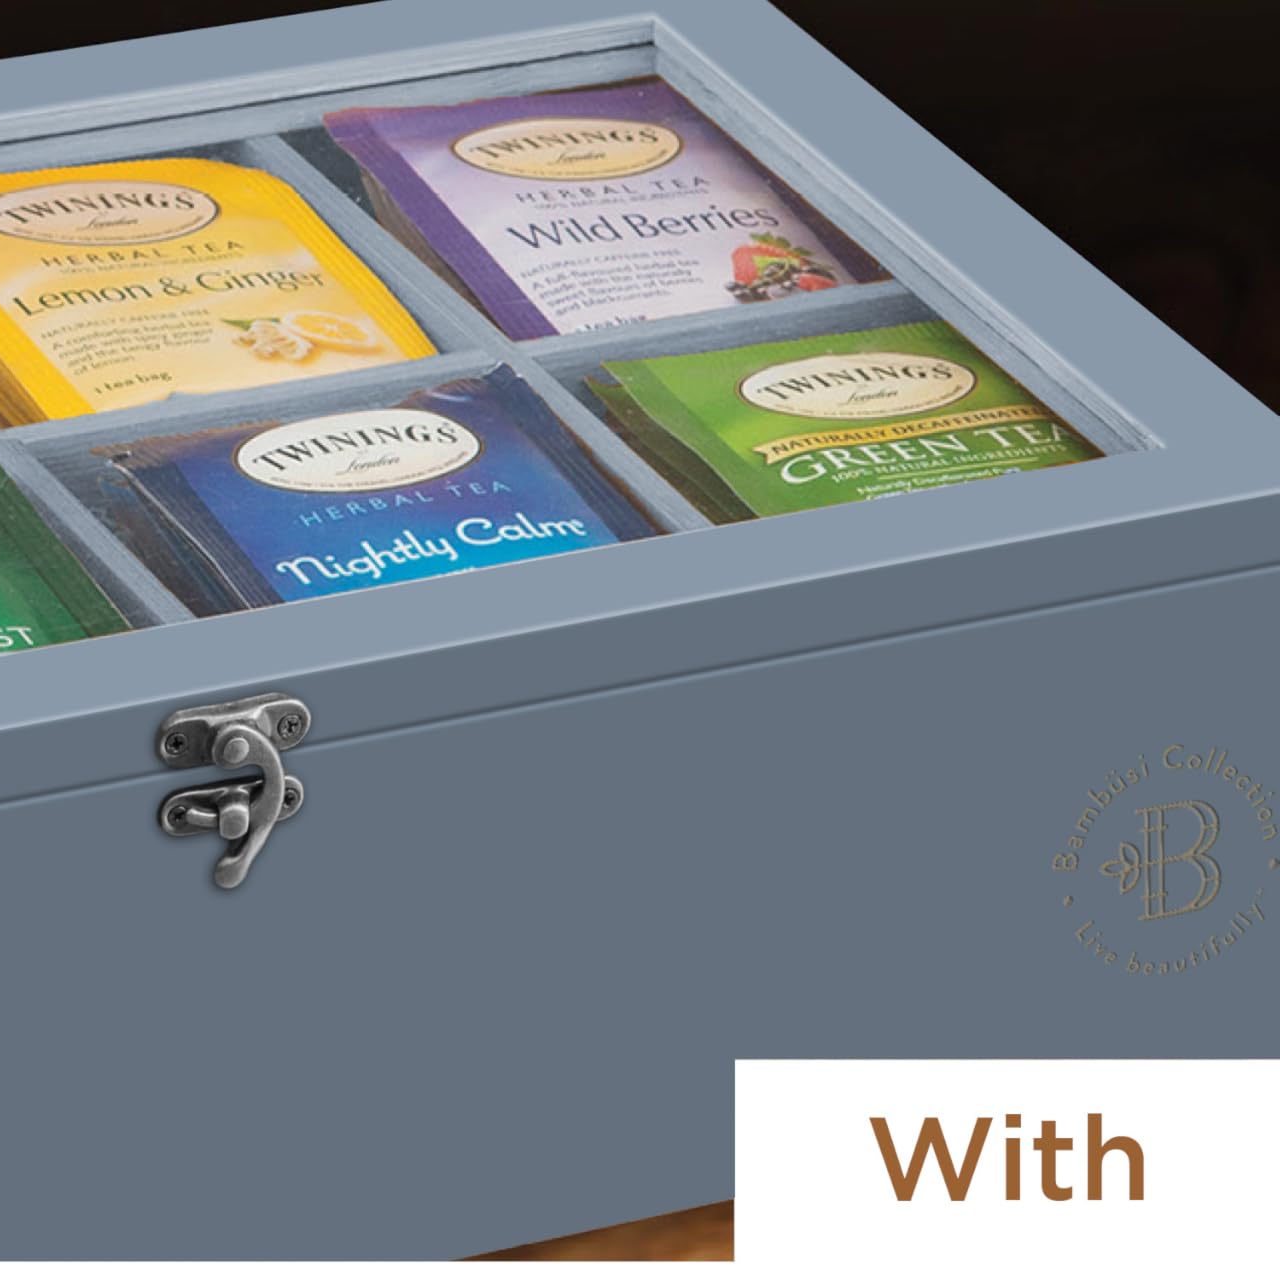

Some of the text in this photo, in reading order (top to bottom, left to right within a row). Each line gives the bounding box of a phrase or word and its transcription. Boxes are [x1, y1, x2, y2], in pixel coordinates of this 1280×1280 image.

[469, 127, 659, 159] TWININGS
[515, 175, 712, 203] HERBAL TEA
[505, 205, 780, 249] Wild Berries
[41, 240, 244, 269] HERBAL TEA
[12, 268, 326, 316] Lemon & Ginger
[106, 370, 173, 391] tea bag
[757, 363, 953, 400] TWININGS
[251, 423, 461, 472] TWININGS
[771, 429, 888, 455] NATURALLY
[781, 434, 969, 485] GREEN
[876, 456, 940, 475] NATURAL
[944, 443, 1068, 466] INGREDIENTS
[299, 480, 513, 528] HERBAL TEA
[276, 513, 587, 585] Nightly Calm
[1052, 743, 1280, 871] Bambüsi Collection
[1075, 887, 1265, 976] Live beautifully
